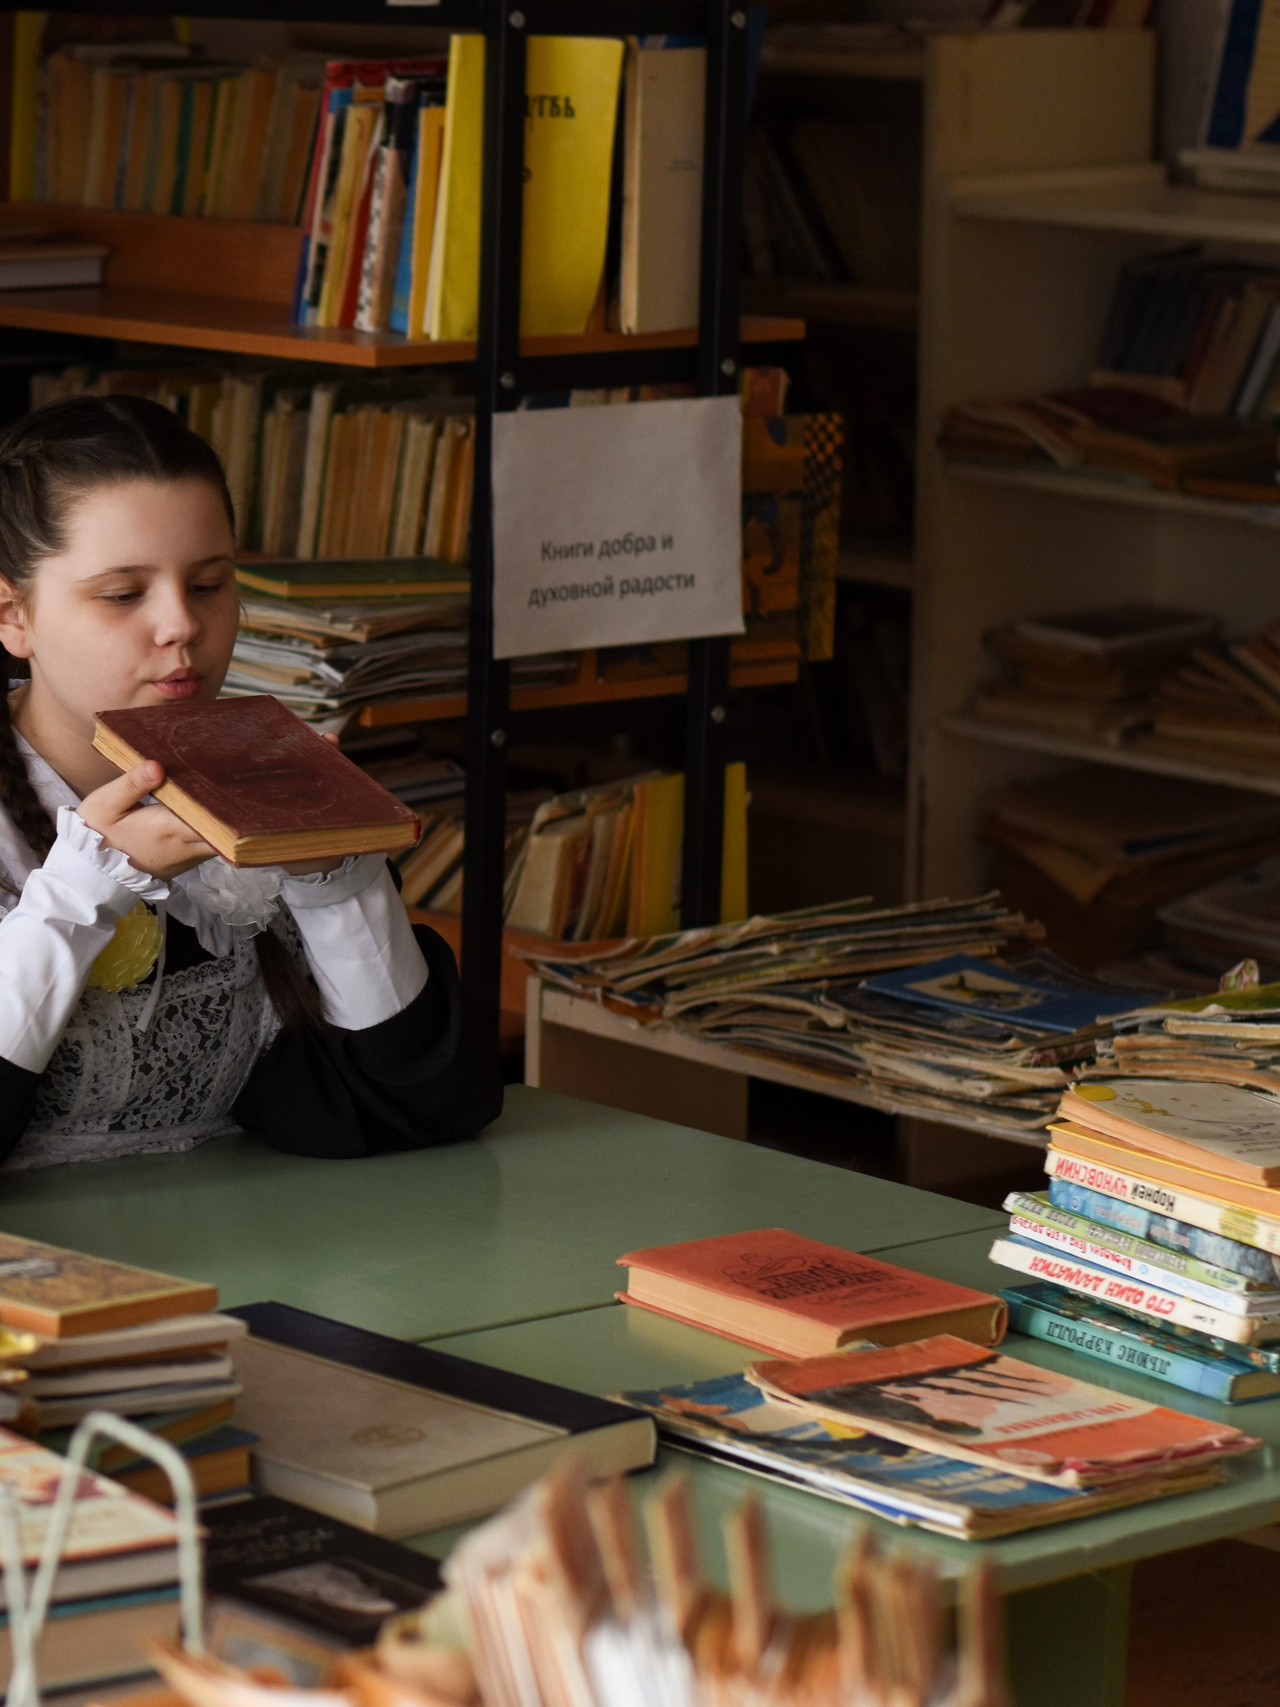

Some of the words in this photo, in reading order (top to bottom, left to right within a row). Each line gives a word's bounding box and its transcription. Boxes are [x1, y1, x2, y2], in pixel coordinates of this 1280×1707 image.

[540, 541, 594, 561] Книги
[598, 532, 656, 559] добра
[662, 535, 673, 549] и
[528, 575, 614, 609] духовной
[620, 573, 695, 599] радости
[1055, 1157, 1127, 1197] ЧУКОВСКИЙ
[1131, 1183, 1176, 1212] Корней
[1028, 1256, 1106, 1292] ДАЛМАТИН
[1104, 1282, 1146, 1304] ОДИН
[1145, 1294, 1176, 1315] СТО
[1046, 1321, 1114, 1356] КЭРРОЛЛ
[1118, 1344, 1171, 1376] ЛЬЮИС
